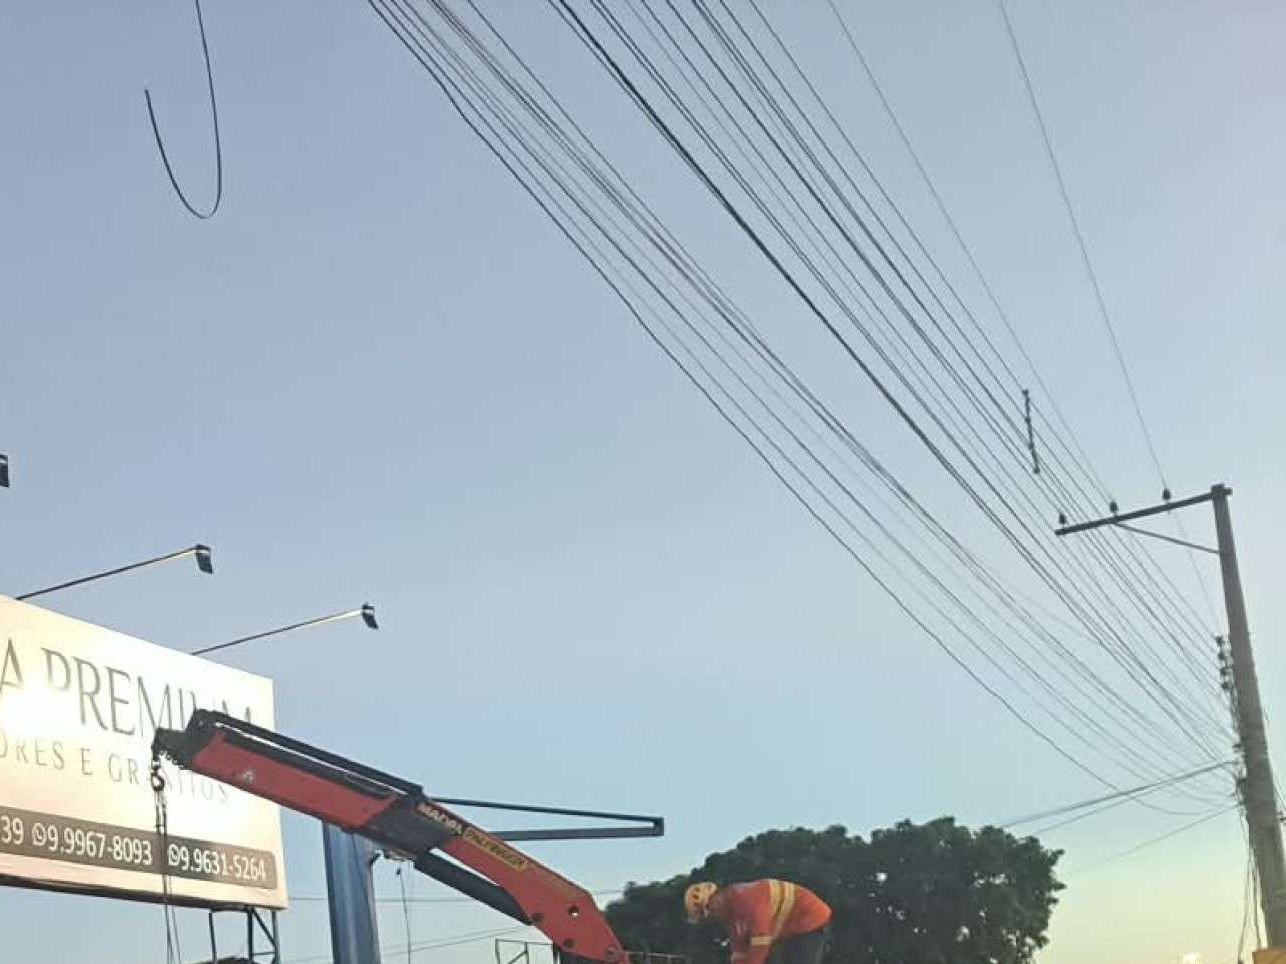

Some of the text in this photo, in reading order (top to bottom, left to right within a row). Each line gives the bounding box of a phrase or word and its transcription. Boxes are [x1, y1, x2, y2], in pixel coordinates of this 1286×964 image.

[41, 647, 254, 742] PREMI
[80, 747, 94, 776] E
[107, 752, 229, 805] GRNITOS
[47, 823, 153, 867] 9.9967-8093
[177, 845, 266, 881] 9.9631-5264
